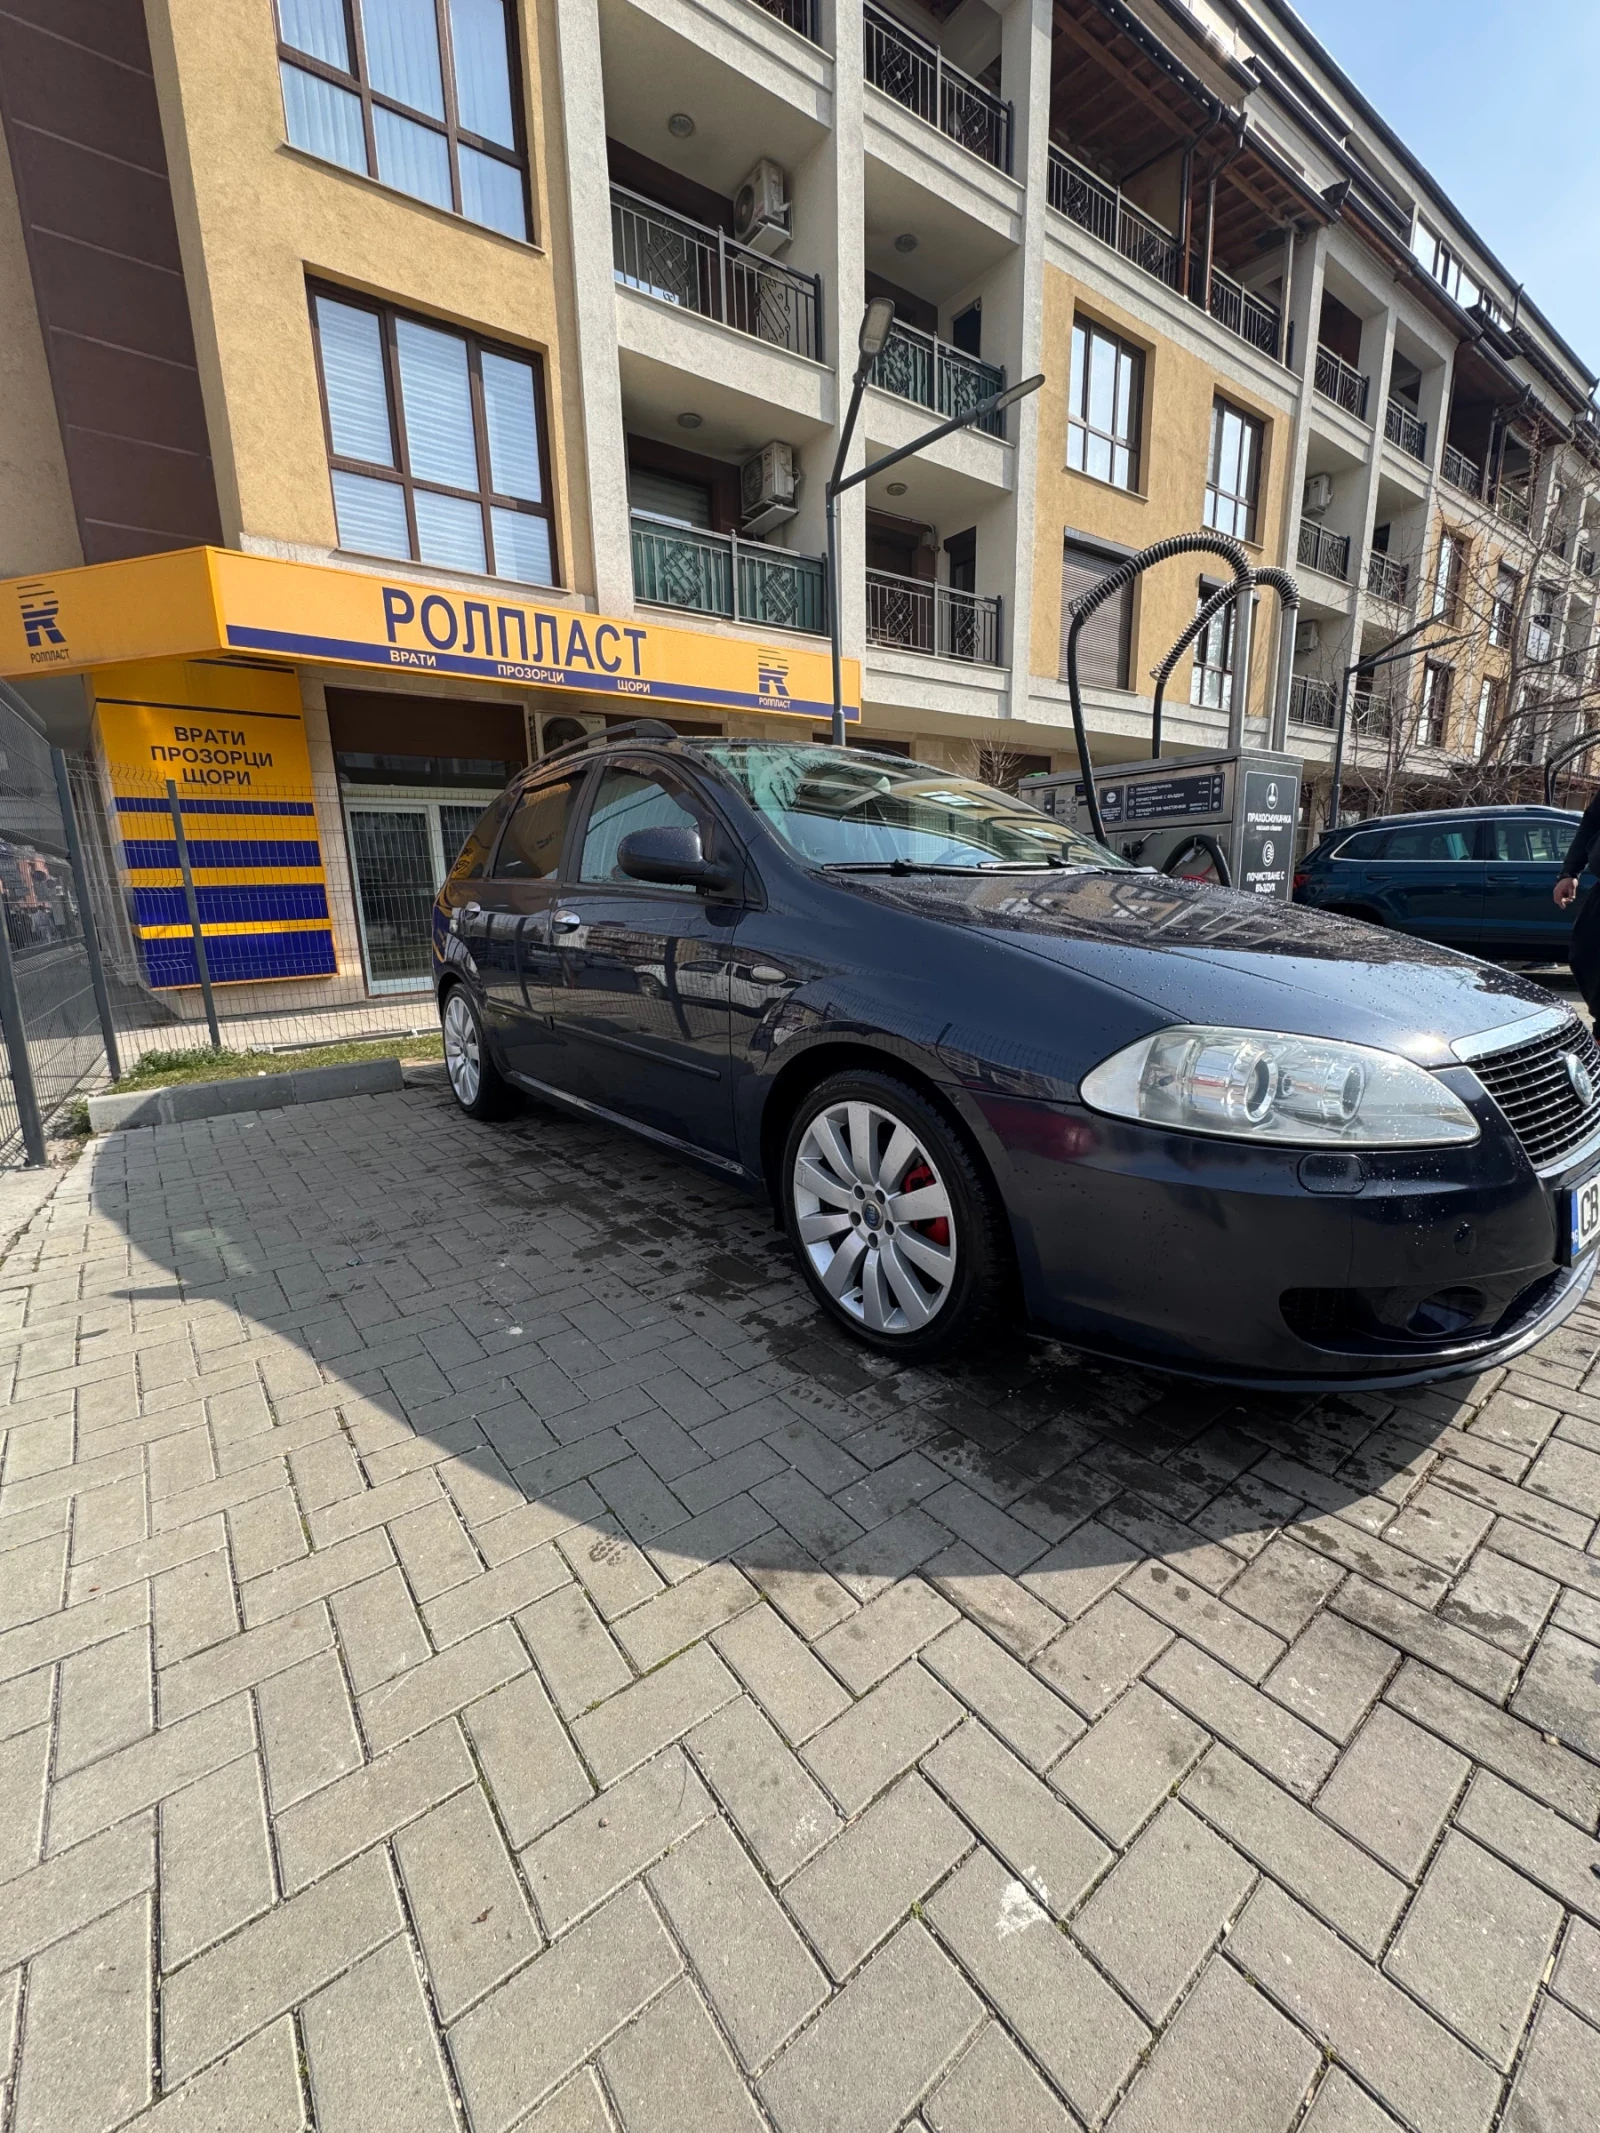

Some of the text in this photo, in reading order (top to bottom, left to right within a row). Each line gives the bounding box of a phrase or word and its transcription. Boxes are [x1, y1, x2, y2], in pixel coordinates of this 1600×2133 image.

[382, 586, 647, 676] РОЛПЛАСТ
[30, 648, 70, 664] РОЛПЛАСТ
[390, 650, 437, 667] ВРАТИ
[497, 664, 565, 684] ПРОЗОРЦИ
[617, 679, 651, 694] ЩОРИ
[758, 696, 791, 709] РОЛПЛАСТ
[174, 726, 246, 746] ВРАТИ
[150, 745, 273, 769] ПРОЗОРЦИ
[182, 768, 251, 786] ЩОРИ
[1247, 812, 1291, 823] ПРАХОСМУКАЧКА
[1246, 871, 1281, 882] ПОЧИСТВАНЕ
[1255, 883, 1276, 894] ВЪЗДУХ
